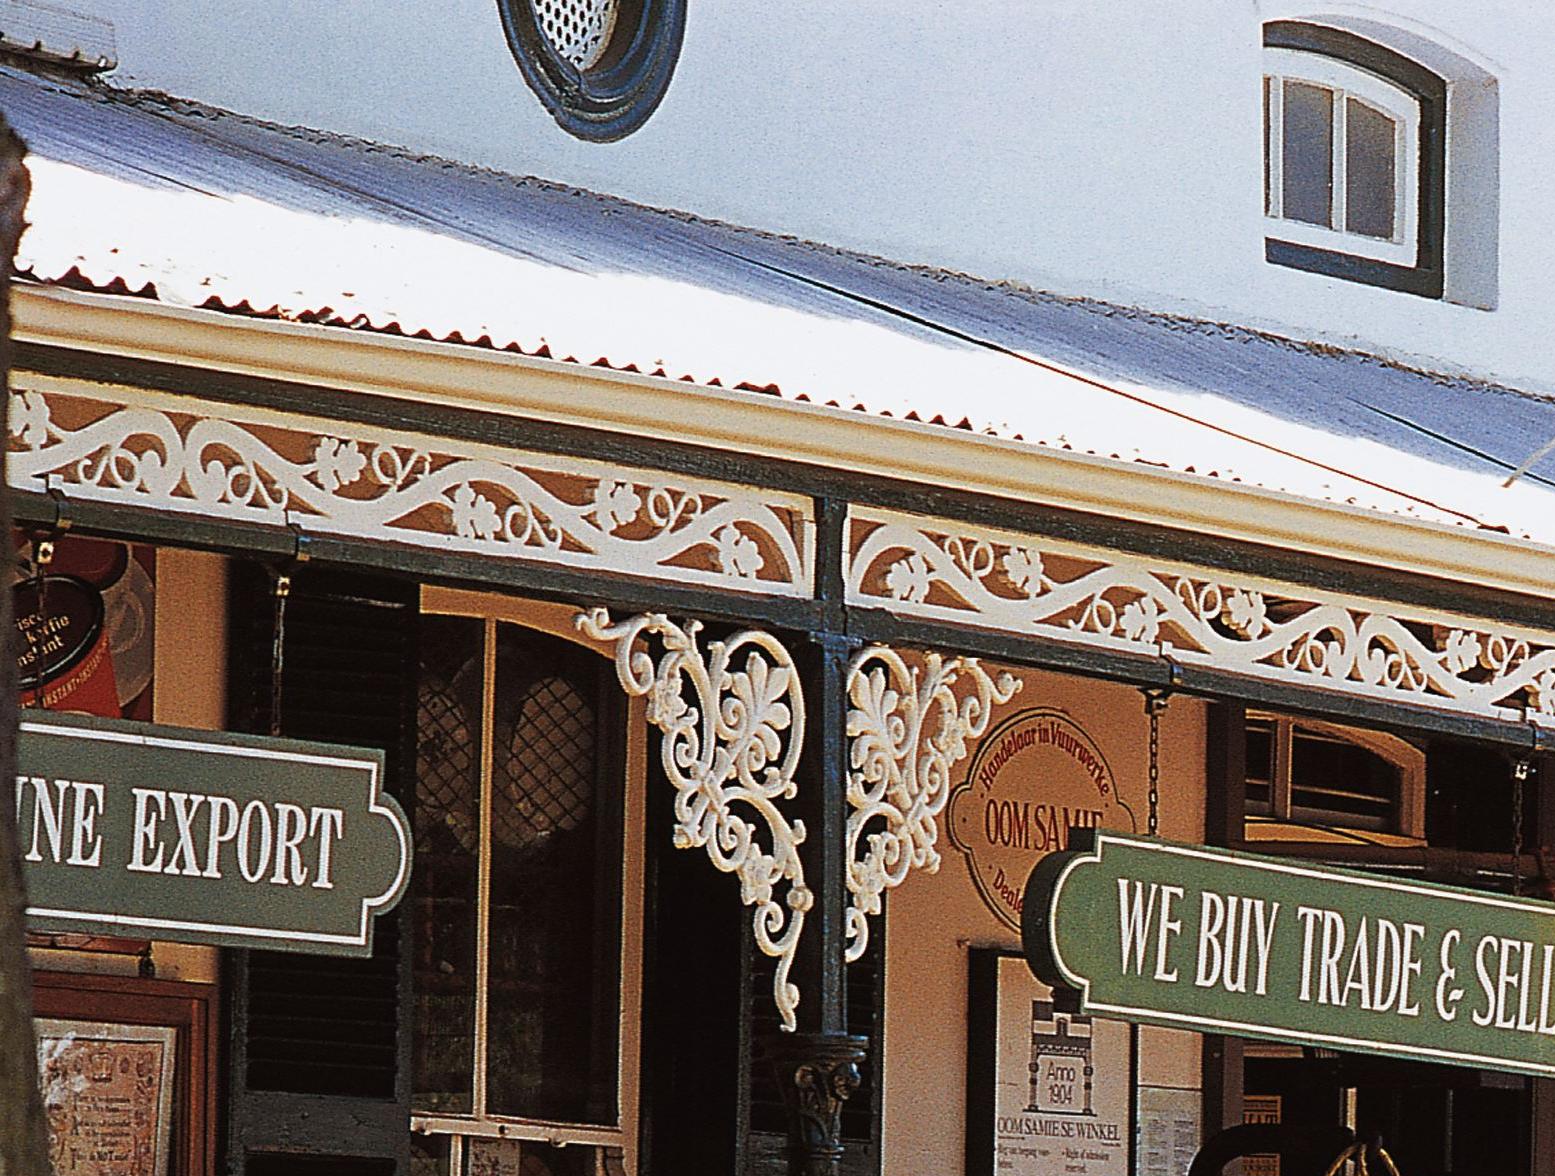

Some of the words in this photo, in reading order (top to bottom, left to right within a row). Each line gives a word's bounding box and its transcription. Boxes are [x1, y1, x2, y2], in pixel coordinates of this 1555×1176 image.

[979, 726, 1036, 791] Handelaar
[1038, 723, 1050, 744] in
[1050, 721, 1110, 797] Vuurwerke
[15, 776, 104, 867] NE
[127, 787, 343, 889] EXPORT
[985, 799, 1030, 850] OOM
[1117, 878, 1184, 982] WE
[1195, 891, 1279, 996] BUY
[1298, 907, 1425, 1016] TRADE
[1436, 929, 1464, 1022] &
[1046, 1061, 1076, 1083] Anno
[1049, 1083, 1073, 1105] 1904
[998, 1117, 1024, 1134] OOM
[1024, 1119, 1059, 1137] SAMIE
[1060, 1121, 1075, 1138] SE
[1076, 1122, 1120, 1141] WINKEL
